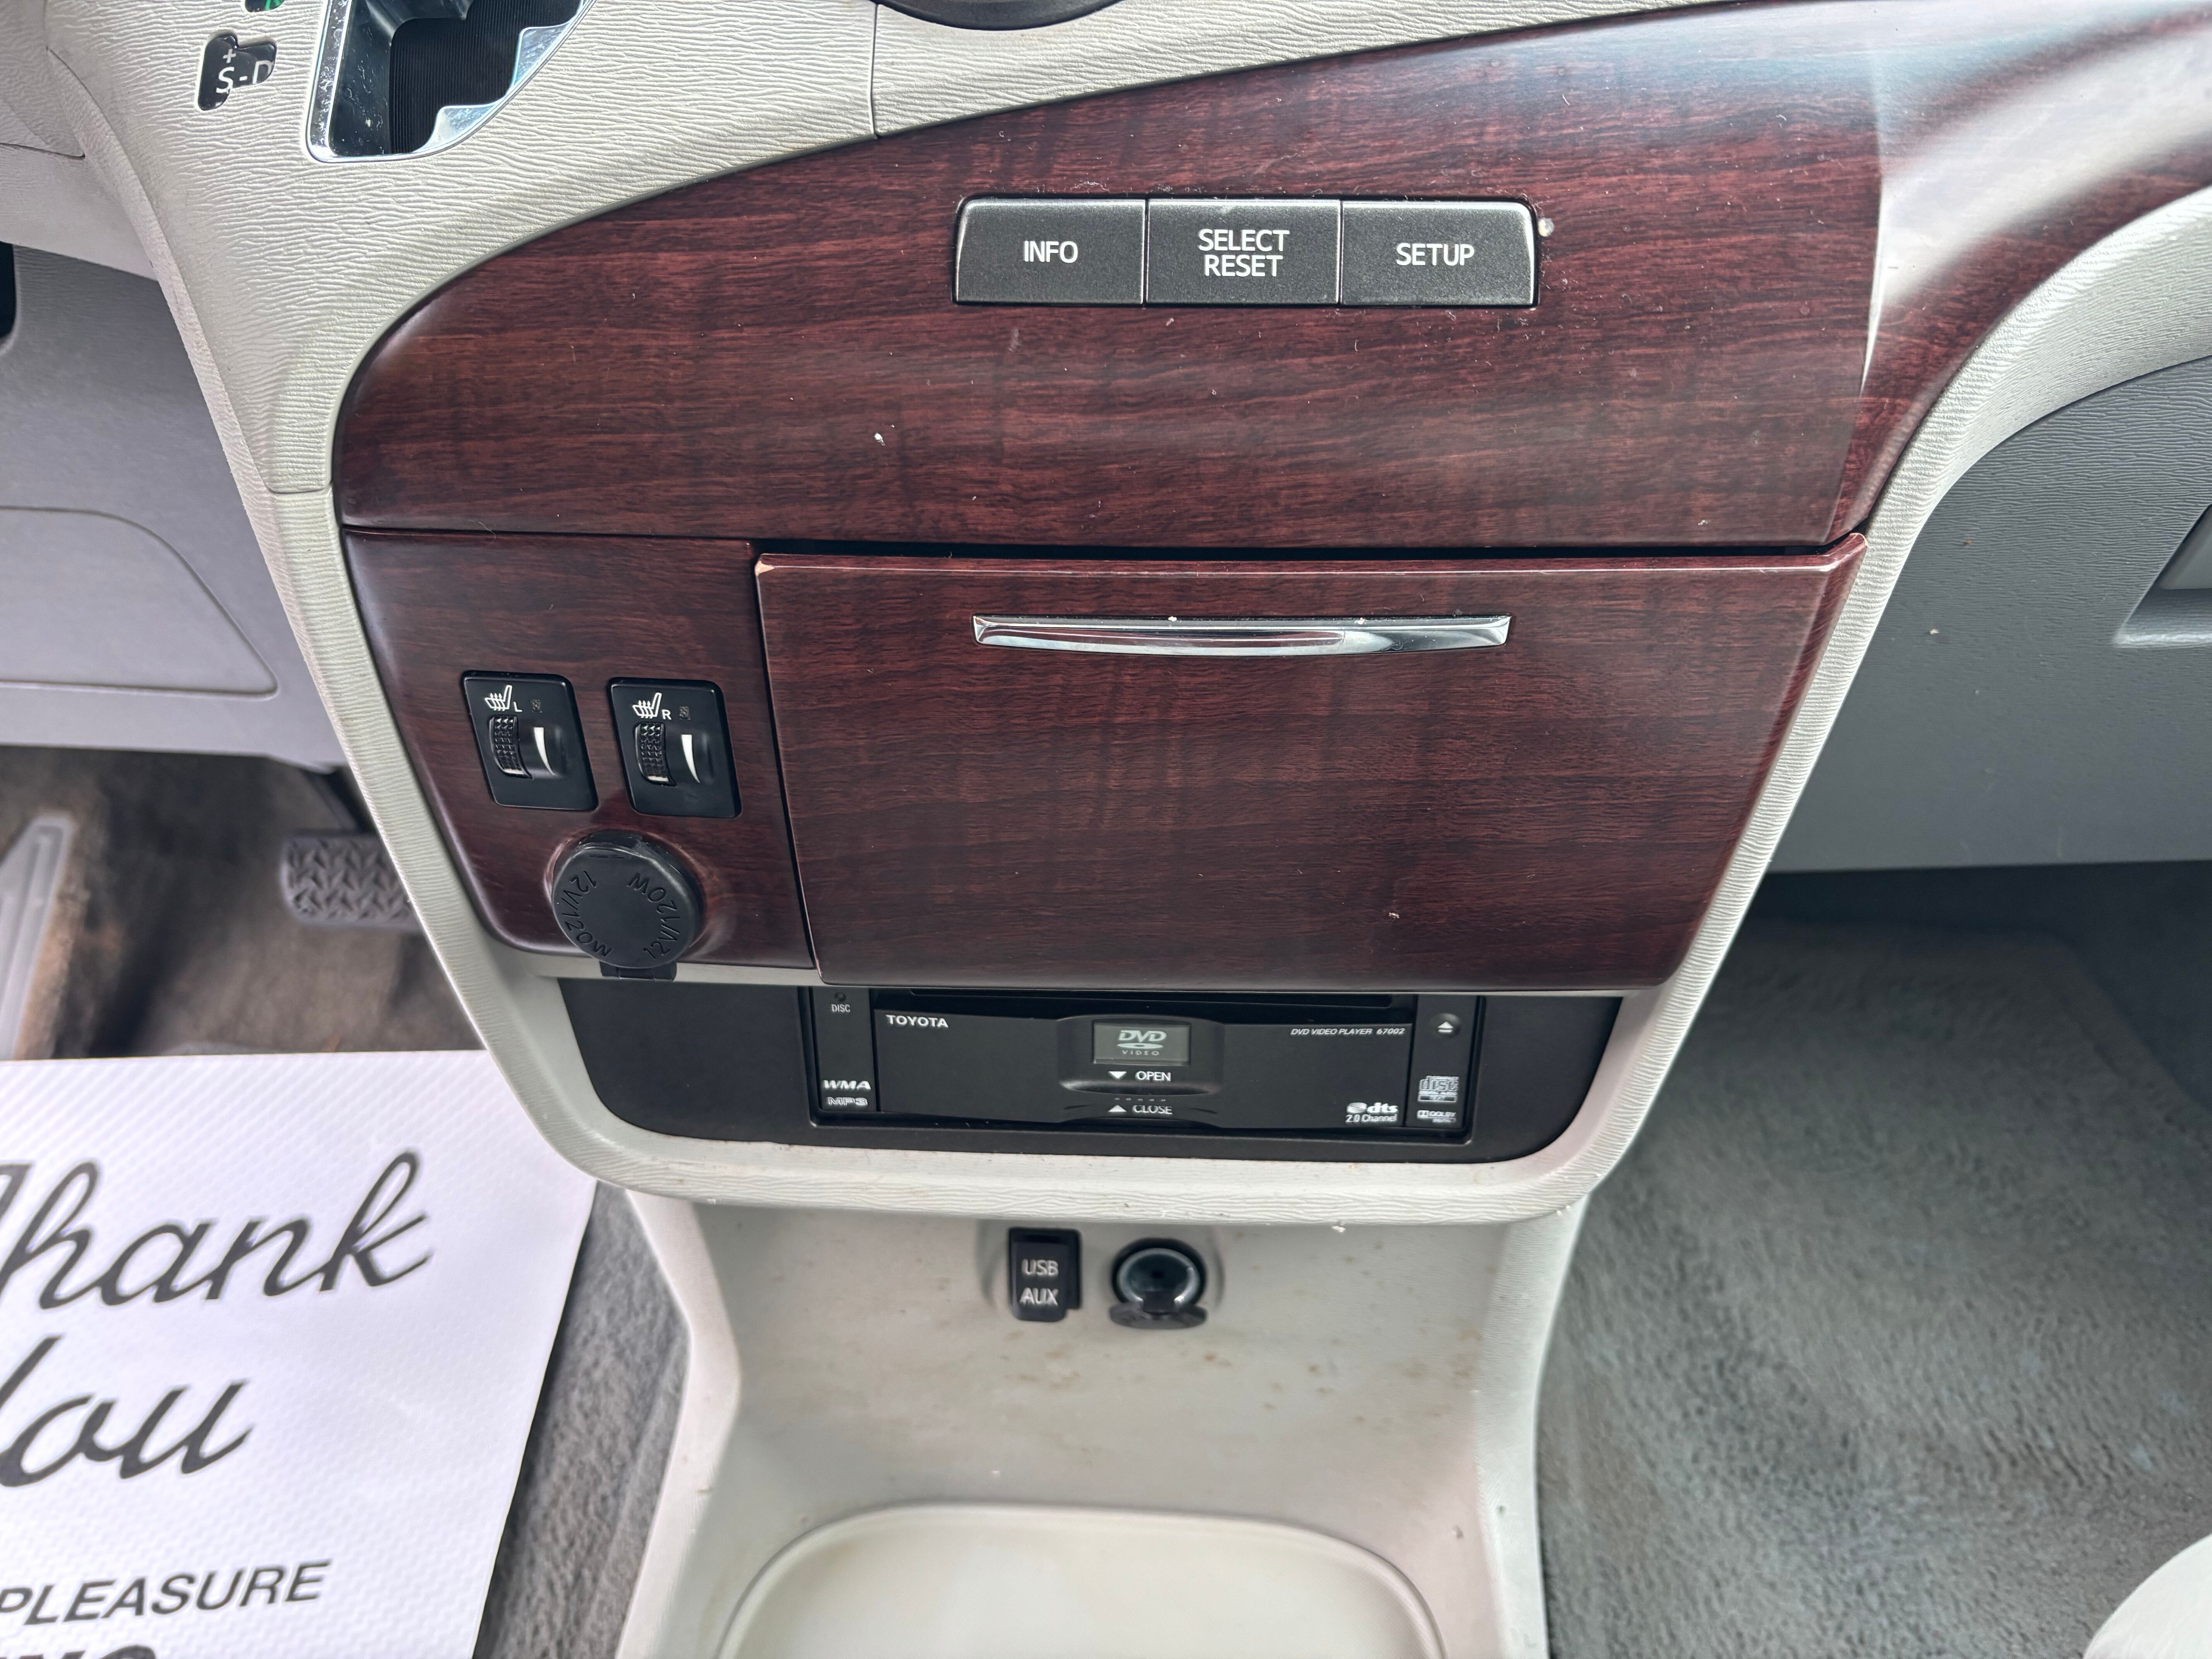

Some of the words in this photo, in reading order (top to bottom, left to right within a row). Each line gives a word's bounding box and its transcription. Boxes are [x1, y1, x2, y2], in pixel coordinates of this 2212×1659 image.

[1199, 228, 1290, 251] SELECT
[1024, 241, 1078, 263] INFO
[1396, 242, 1475, 266] SETUP
[1204, 254, 1283, 277] RESET
[514, 702, 522, 712] L
[662, 709, 672, 720] R
[831, 1004, 851, 1013] DISC
[886, 1014, 949, 1028] TOYOTA
[1118, 1030, 1167, 1042] DVD
[1135, 1071, 1171, 1082] OPEN
[823, 1080, 871, 1090] WMA
[827, 1097, 868, 1106] MP3
[1132, 1105, 1173, 1115] CLOSE
[1367, 1102, 1399, 1113] dts
[1345, 1114, 1361, 1123] 2.0
[1361, 1114, 1398, 1123] Channel
[1021, 1259, 1059, 1277] USB
[1020, 1287, 1058, 1306] AUX
[0, 1560, 331, 1626] PLEASURE
